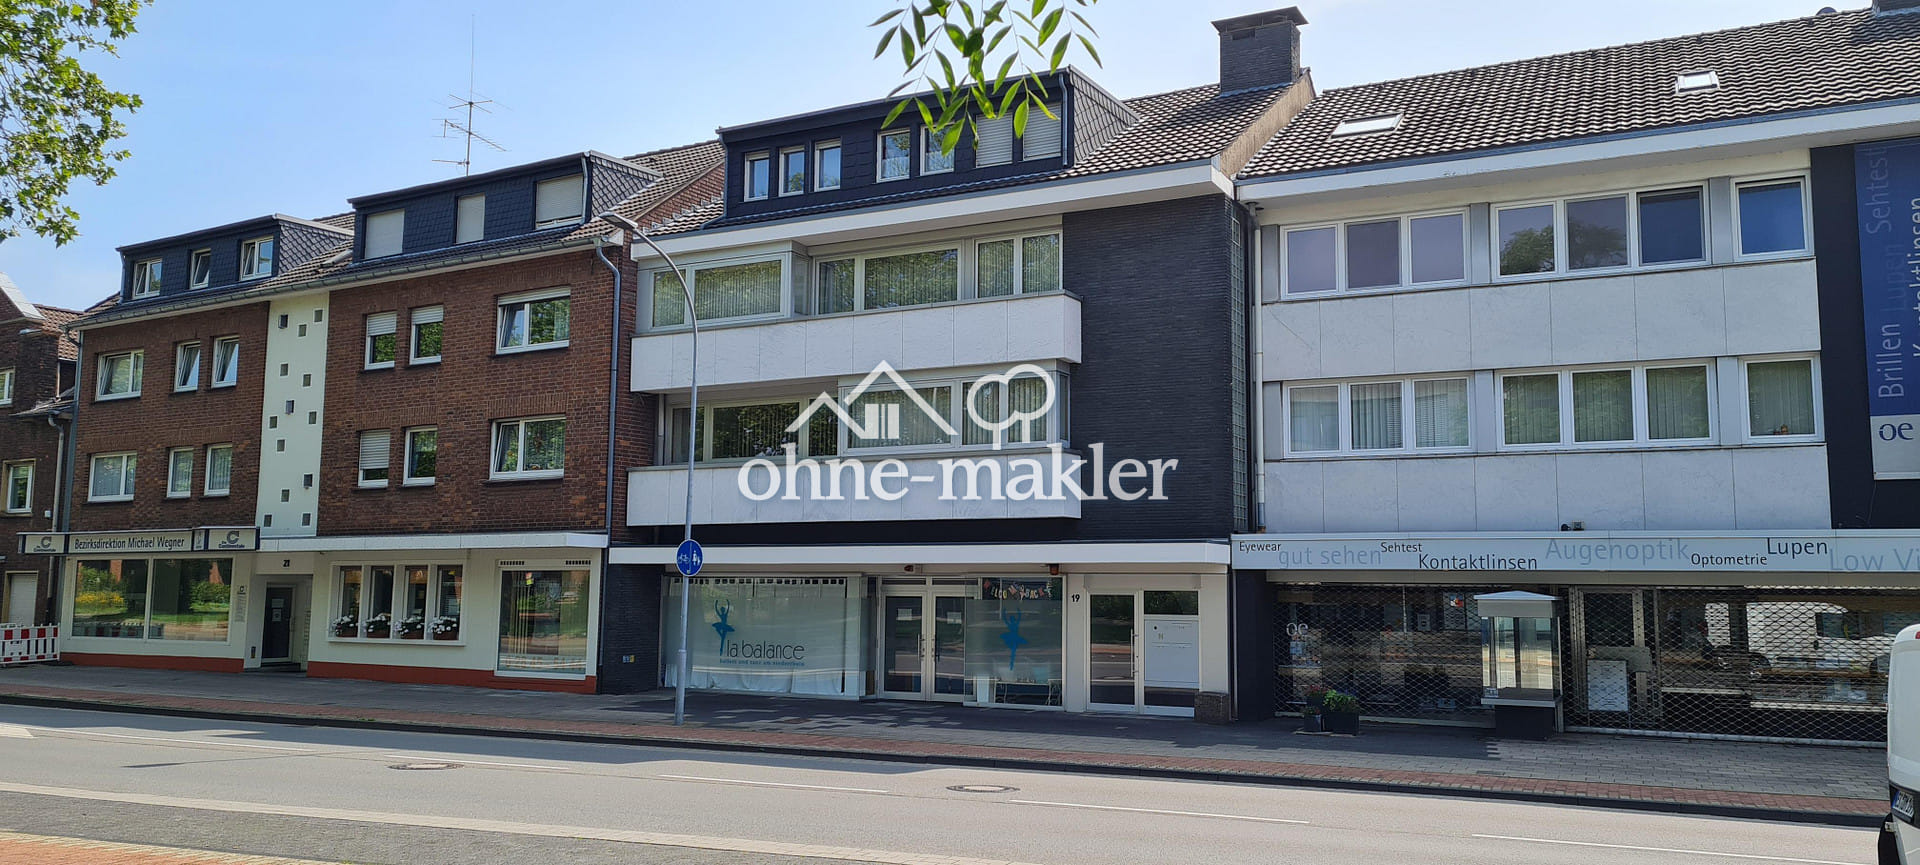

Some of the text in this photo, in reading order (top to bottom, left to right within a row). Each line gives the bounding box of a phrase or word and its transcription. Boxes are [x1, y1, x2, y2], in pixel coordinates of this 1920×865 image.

[1875, 323, 1904, 398] Brillen
[1879, 422, 1914, 441] oe
[74, 538, 126, 550] Bezirksdirektion
[128, 536, 155, 549] Michael
[157, 536, 185, 550] Wegner
[1239, 541, 1281, 553] Eyewear
[1380, 541, 1422, 553] Sehtest
[1545, 538, 1690, 566] Augenoptik
[1767, 537, 1828, 559] Lupen
[1279, 545, 1381, 569] gut sehen
[1419, 553, 1537, 570] Kontaktlinsen
[1691, 553, 1767, 568] Optometrie
[1830, 548, 1883, 570] Low
[1071, 594, 1080, 602] 19
[726, 640, 805, 660] la balance
